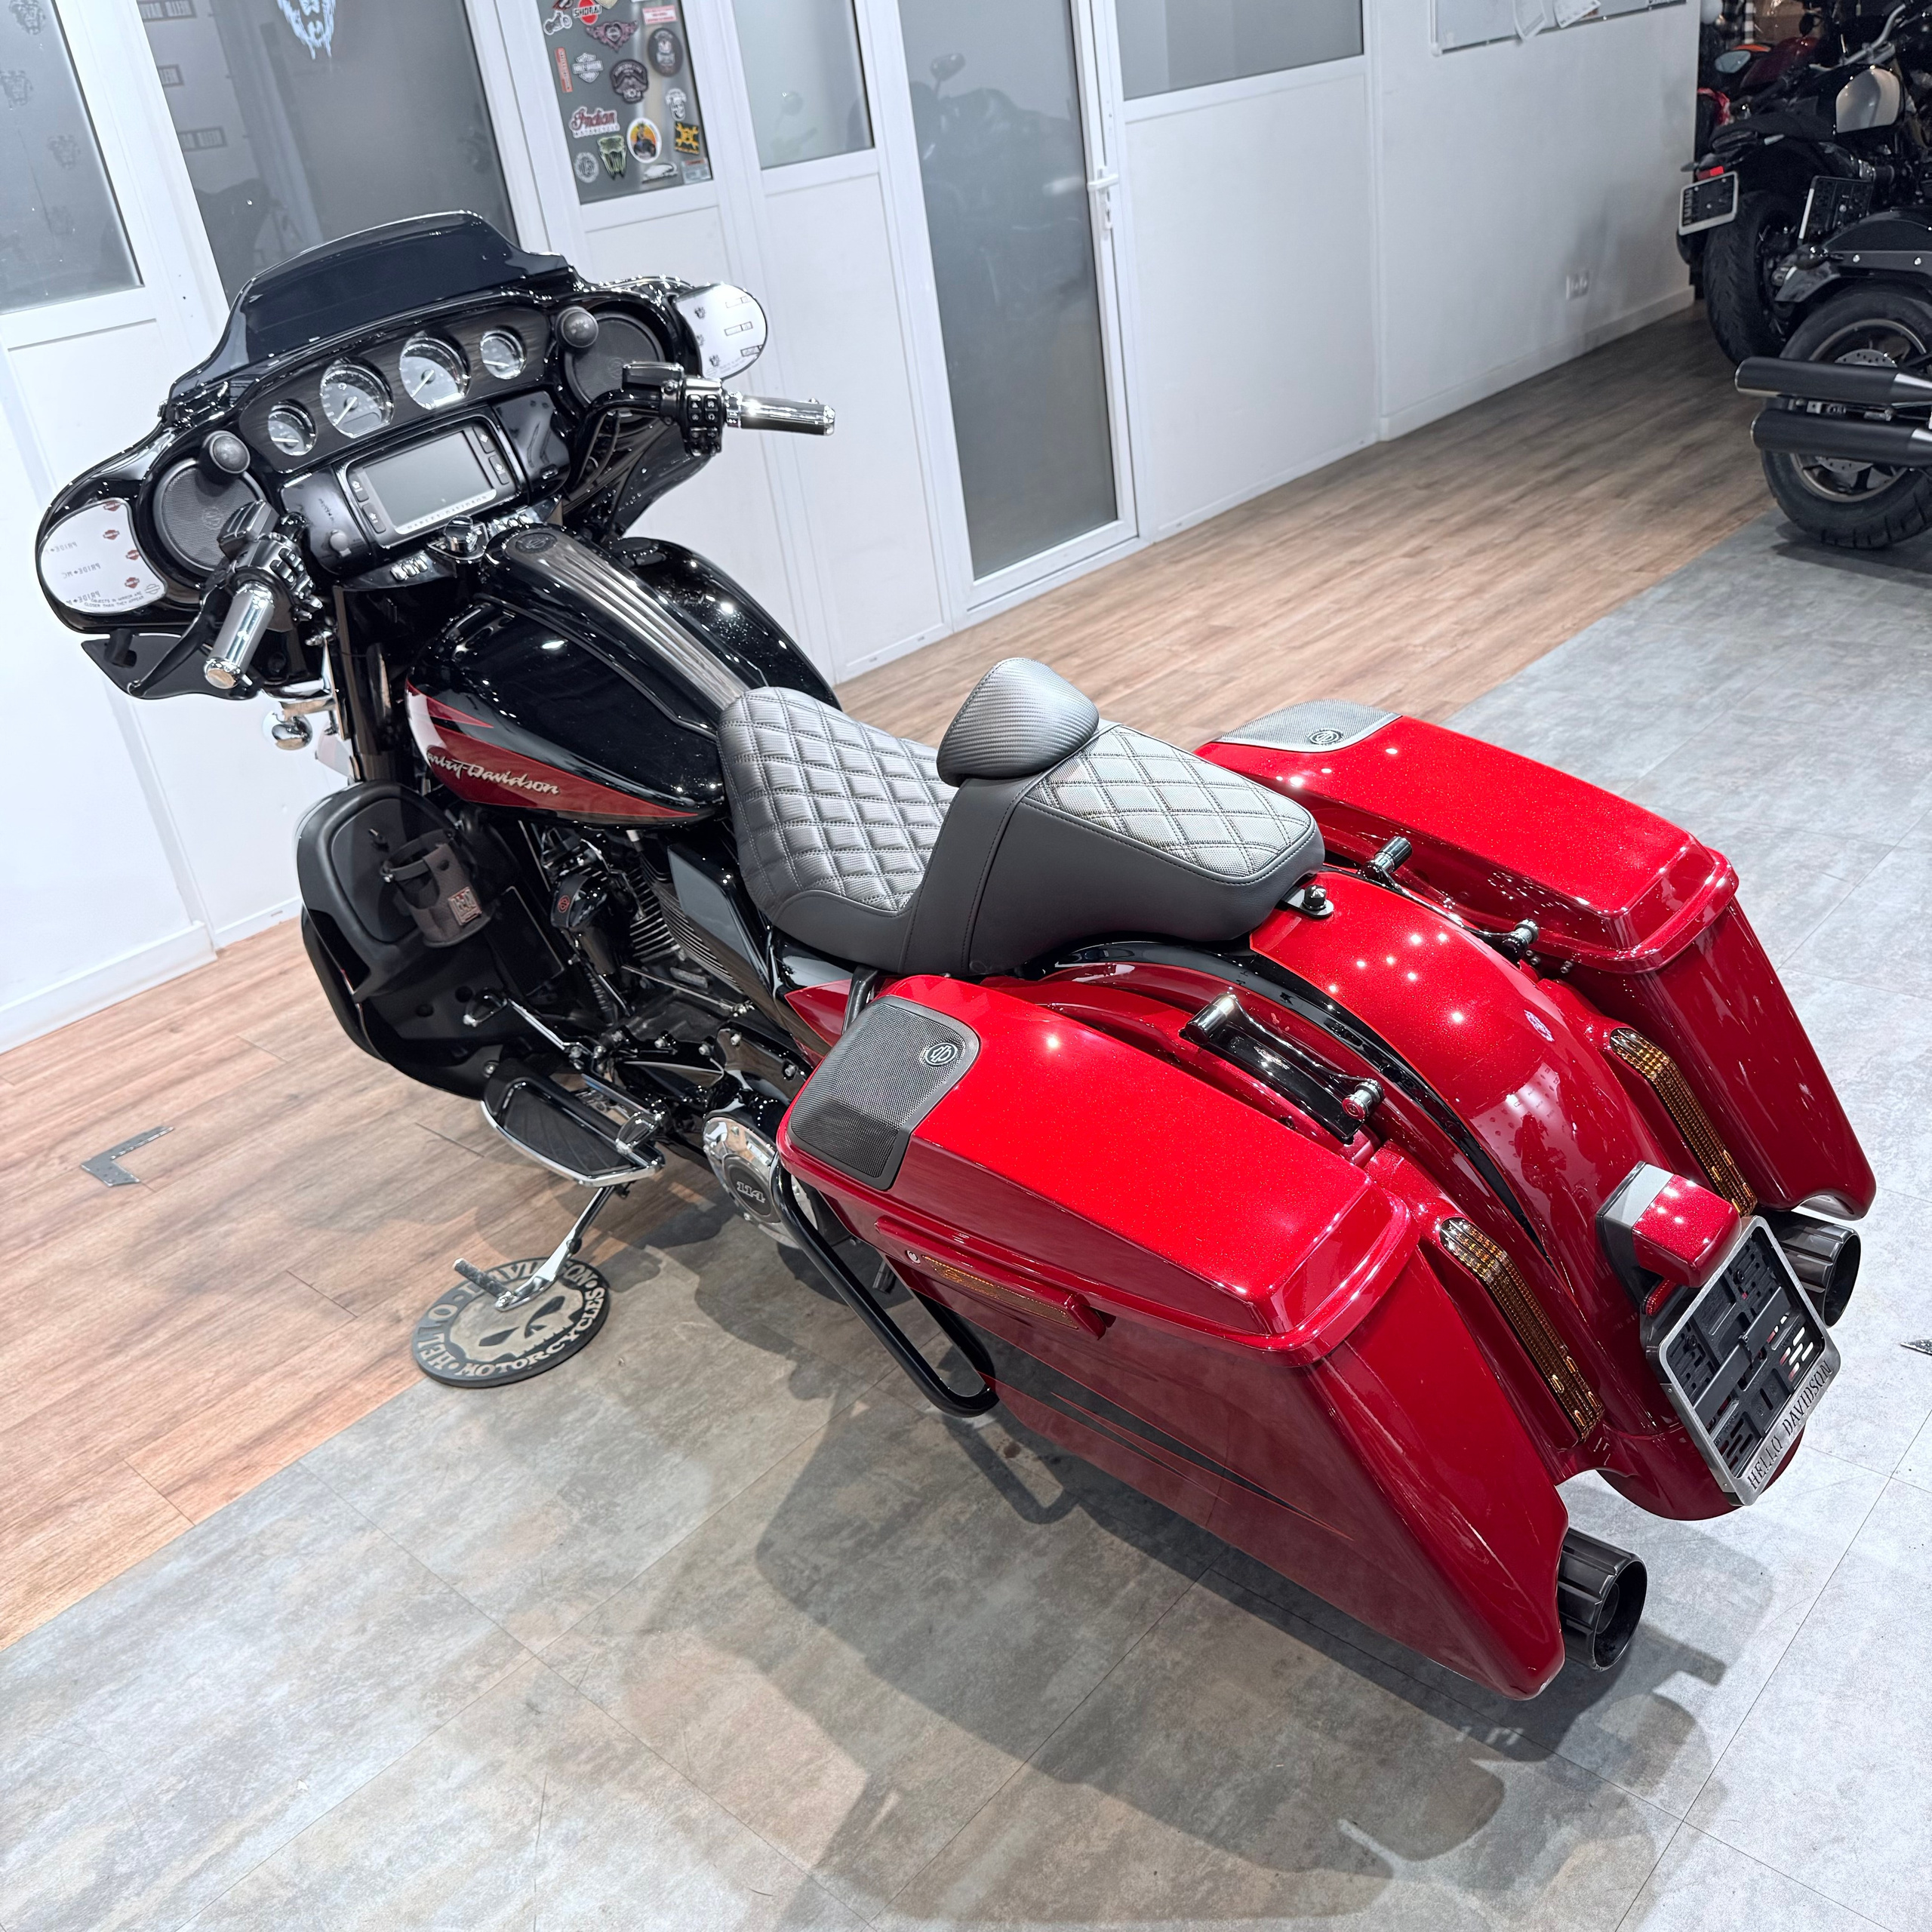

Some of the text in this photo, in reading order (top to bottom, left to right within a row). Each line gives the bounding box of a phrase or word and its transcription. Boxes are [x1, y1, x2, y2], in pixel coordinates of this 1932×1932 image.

[426, 752, 559, 795] arley-Davidson
[736, 1181, 765, 1203] 114
[454, 1286, 605, 1376] MOTORCYCLES
[1747, 1435, 1783, 1491] HELLO
[1782, 1360, 1832, 1435] DAVIDSON
